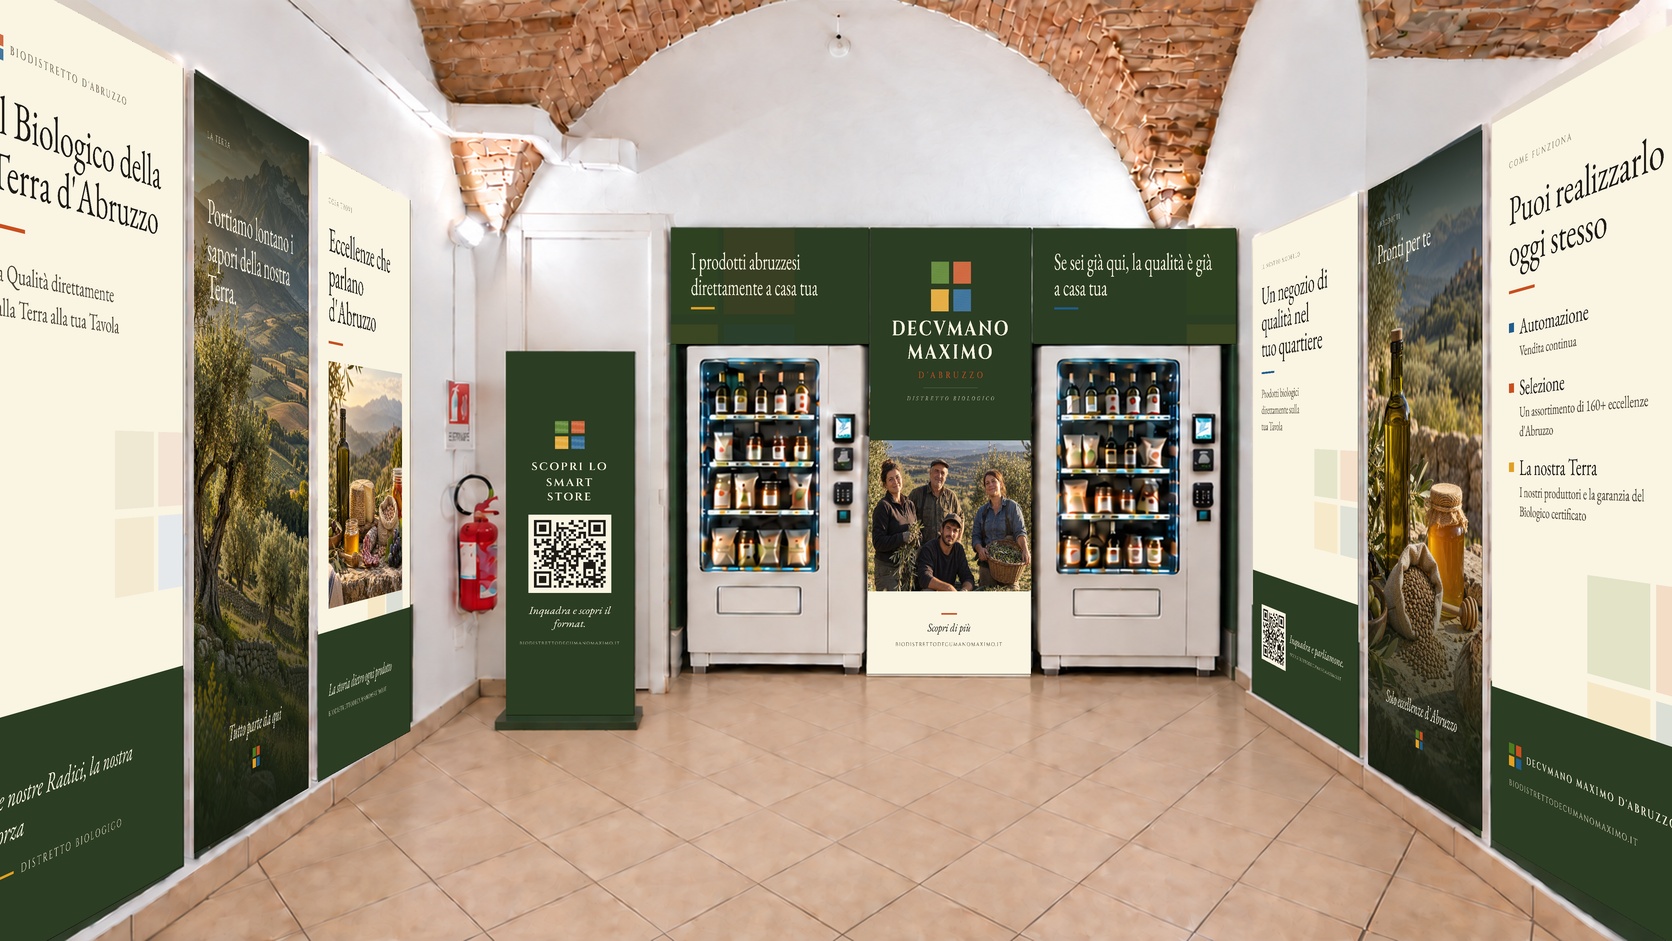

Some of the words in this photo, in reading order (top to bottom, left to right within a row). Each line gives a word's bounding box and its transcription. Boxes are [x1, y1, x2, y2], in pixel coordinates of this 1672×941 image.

[10, 46, 78, 84] BIODISTRETTO
[82, 78, 127, 105] D'ABRUZZO
[0, 96, 6, 136] l
[14, 102, 114, 176] Biologico
[120, 145, 161, 189] della
[1508, 153, 1528, 169] COME
[1532, 133, 1572, 159] FUNZIONA
[1510, 184, 1550, 226] Puoi
[1556, 138, 1664, 208] realizzarlo
[58, 173, 158, 234] d'Abruzzo
[208, 198, 253, 240] Portiamo
[255, 218, 289, 252] lontano
[290, 234, 294, 254] i
[328, 228, 374, 268] Eccellenze
[377, 248, 391, 273] che
[1378, 237, 1404, 264] Pronti
[1406, 236, 1420, 262] per
[1422, 232, 1431, 248] te
[1510, 230, 1545, 275] oggi
[1551, 218, 1607, 254] stesso
[208, 244, 238, 274] sapori
[240, 249, 262, 277] della
[263, 262, 290, 286] nostra
[691, 253, 696, 270] I
[699, 252, 746, 276] prodotti
[750, 252, 800, 270] abruzzesi
[1054, 253, 1067, 271] Se
[1070, 254, 1084, 270] sei
[1087, 254, 1103, 277] già
[1106, 254, 1129, 277] qui,
[1132, 252, 1142, 270] la
[1144, 252, 1184, 277] qualità
[1187, 254, 1193, 270] è
[1196, 254, 1212, 277] già
[7, 265, 48, 290] Qualità
[52, 274, 114, 302] direttamente
[208, 274, 237, 305] Terra.
[328, 268, 364, 296] parlano
[691, 278, 763, 296] direttamente
[766, 285, 772, 296] a
[774, 285, 797, 296] casa
[800, 283, 818, 296] tua
[1054, 284, 1060, 296] a
[1063, 284, 1086, 296] casa
[1089, 284, 1107, 296] tua
[1262, 286, 1276, 305] Un
[1278, 276, 1314, 305] negozio
[1318, 268, 1328, 290] di
[0, 298, 16, 318] lla
[18, 300, 48, 323] Terra
[50, 307, 68, 326] alla
[71, 315, 86, 330] tua
[89, 313, 119, 334] Tavola
[328, 298, 376, 332] d'Abruzzo
[892, 320, 1009, 336] DECVMANO
[1262, 305, 1292, 338] qualità
[1294, 302, 1309, 325] nel
[1519, 308, 1589, 334] Automazione
[908, 344, 993, 360] MAXIMO
[1262, 344, 1276, 358] tuo
[1278, 333, 1323, 362] quartiere
[1519, 342, 1544, 356] Vendita
[1546, 338, 1577, 353] continua
[1262, 388, 1279, 398] Prodotti
[1519, 377, 1565, 396] Selezione
[1519, 406, 1530, 418] Un
[1531, 403, 1575, 417] assortimento
[1577, 400, 1584, 413] di
[1586, 399, 1606, 412] 160+
[1608, 395, 1649, 410] eccellenze
[1519, 425, 1554, 437] d'Abruzzo
[532, 462, 582, 471] SCOPRI
[589, 462, 607, 471] LO
[1519, 459, 1532, 476] La
[1534, 461, 1565, 476] nostra
[1568, 458, 1597, 476] Terra
[546, 478, 593, 487] SMART
[1519, 487, 1523, 498] I
[1524, 488, 1542, 499] nostri
[1544, 488, 1581, 503] produttori
[1583, 491, 1587, 500] e
[1588, 488, 1596, 501] la
[1596, 490, 1630, 505] garanzia
[1632, 489, 1645, 502] del
[547, 492, 591, 501] STORE
[1519, 506, 1550, 522] Biologico
[1551, 508, 1587, 521] certificato
[528, 606, 570, 618] Inquadra
[578, 606, 602, 618] scopri
[604, 606, 611, 615] il
[551, 619, 586, 630] format.
[927, 623, 949, 635] Scopri
[950, 623, 957, 632] di
[958, 624, 970, 635] più
[1289, 635, 1310, 652] Inquadra
[328, 683, 336, 696] La
[336, 678, 350, 694] storia
[230, 723, 246, 741] Tutto
[246, 718, 262, 740] parte
[263, 710, 270, 727] da
[272, 706, 282, 729] qui
[1386, 689, 1397, 706] Solo
[1398, 697, 1424, 717] eccellenze
[1424, 706, 1458, 732] d'Abruzzo
[8, 782, 44, 808] nostre
[46, 762, 86, 794] Radici,
[90, 756, 100, 776] la
[103, 748, 133, 771] nostra
[1526, 756, 1572, 784] DECVMANO
[1576, 779, 1614, 802] MAXIMO
[1508, 779, 1638, 846] BIODISTRETTODECUMANOMAXIMO.IT
[0, 822, 24, 845] orza
[21, 841, 72, 872] DISTRETTO
[76, 818, 122, 848] BIOLOGICO
